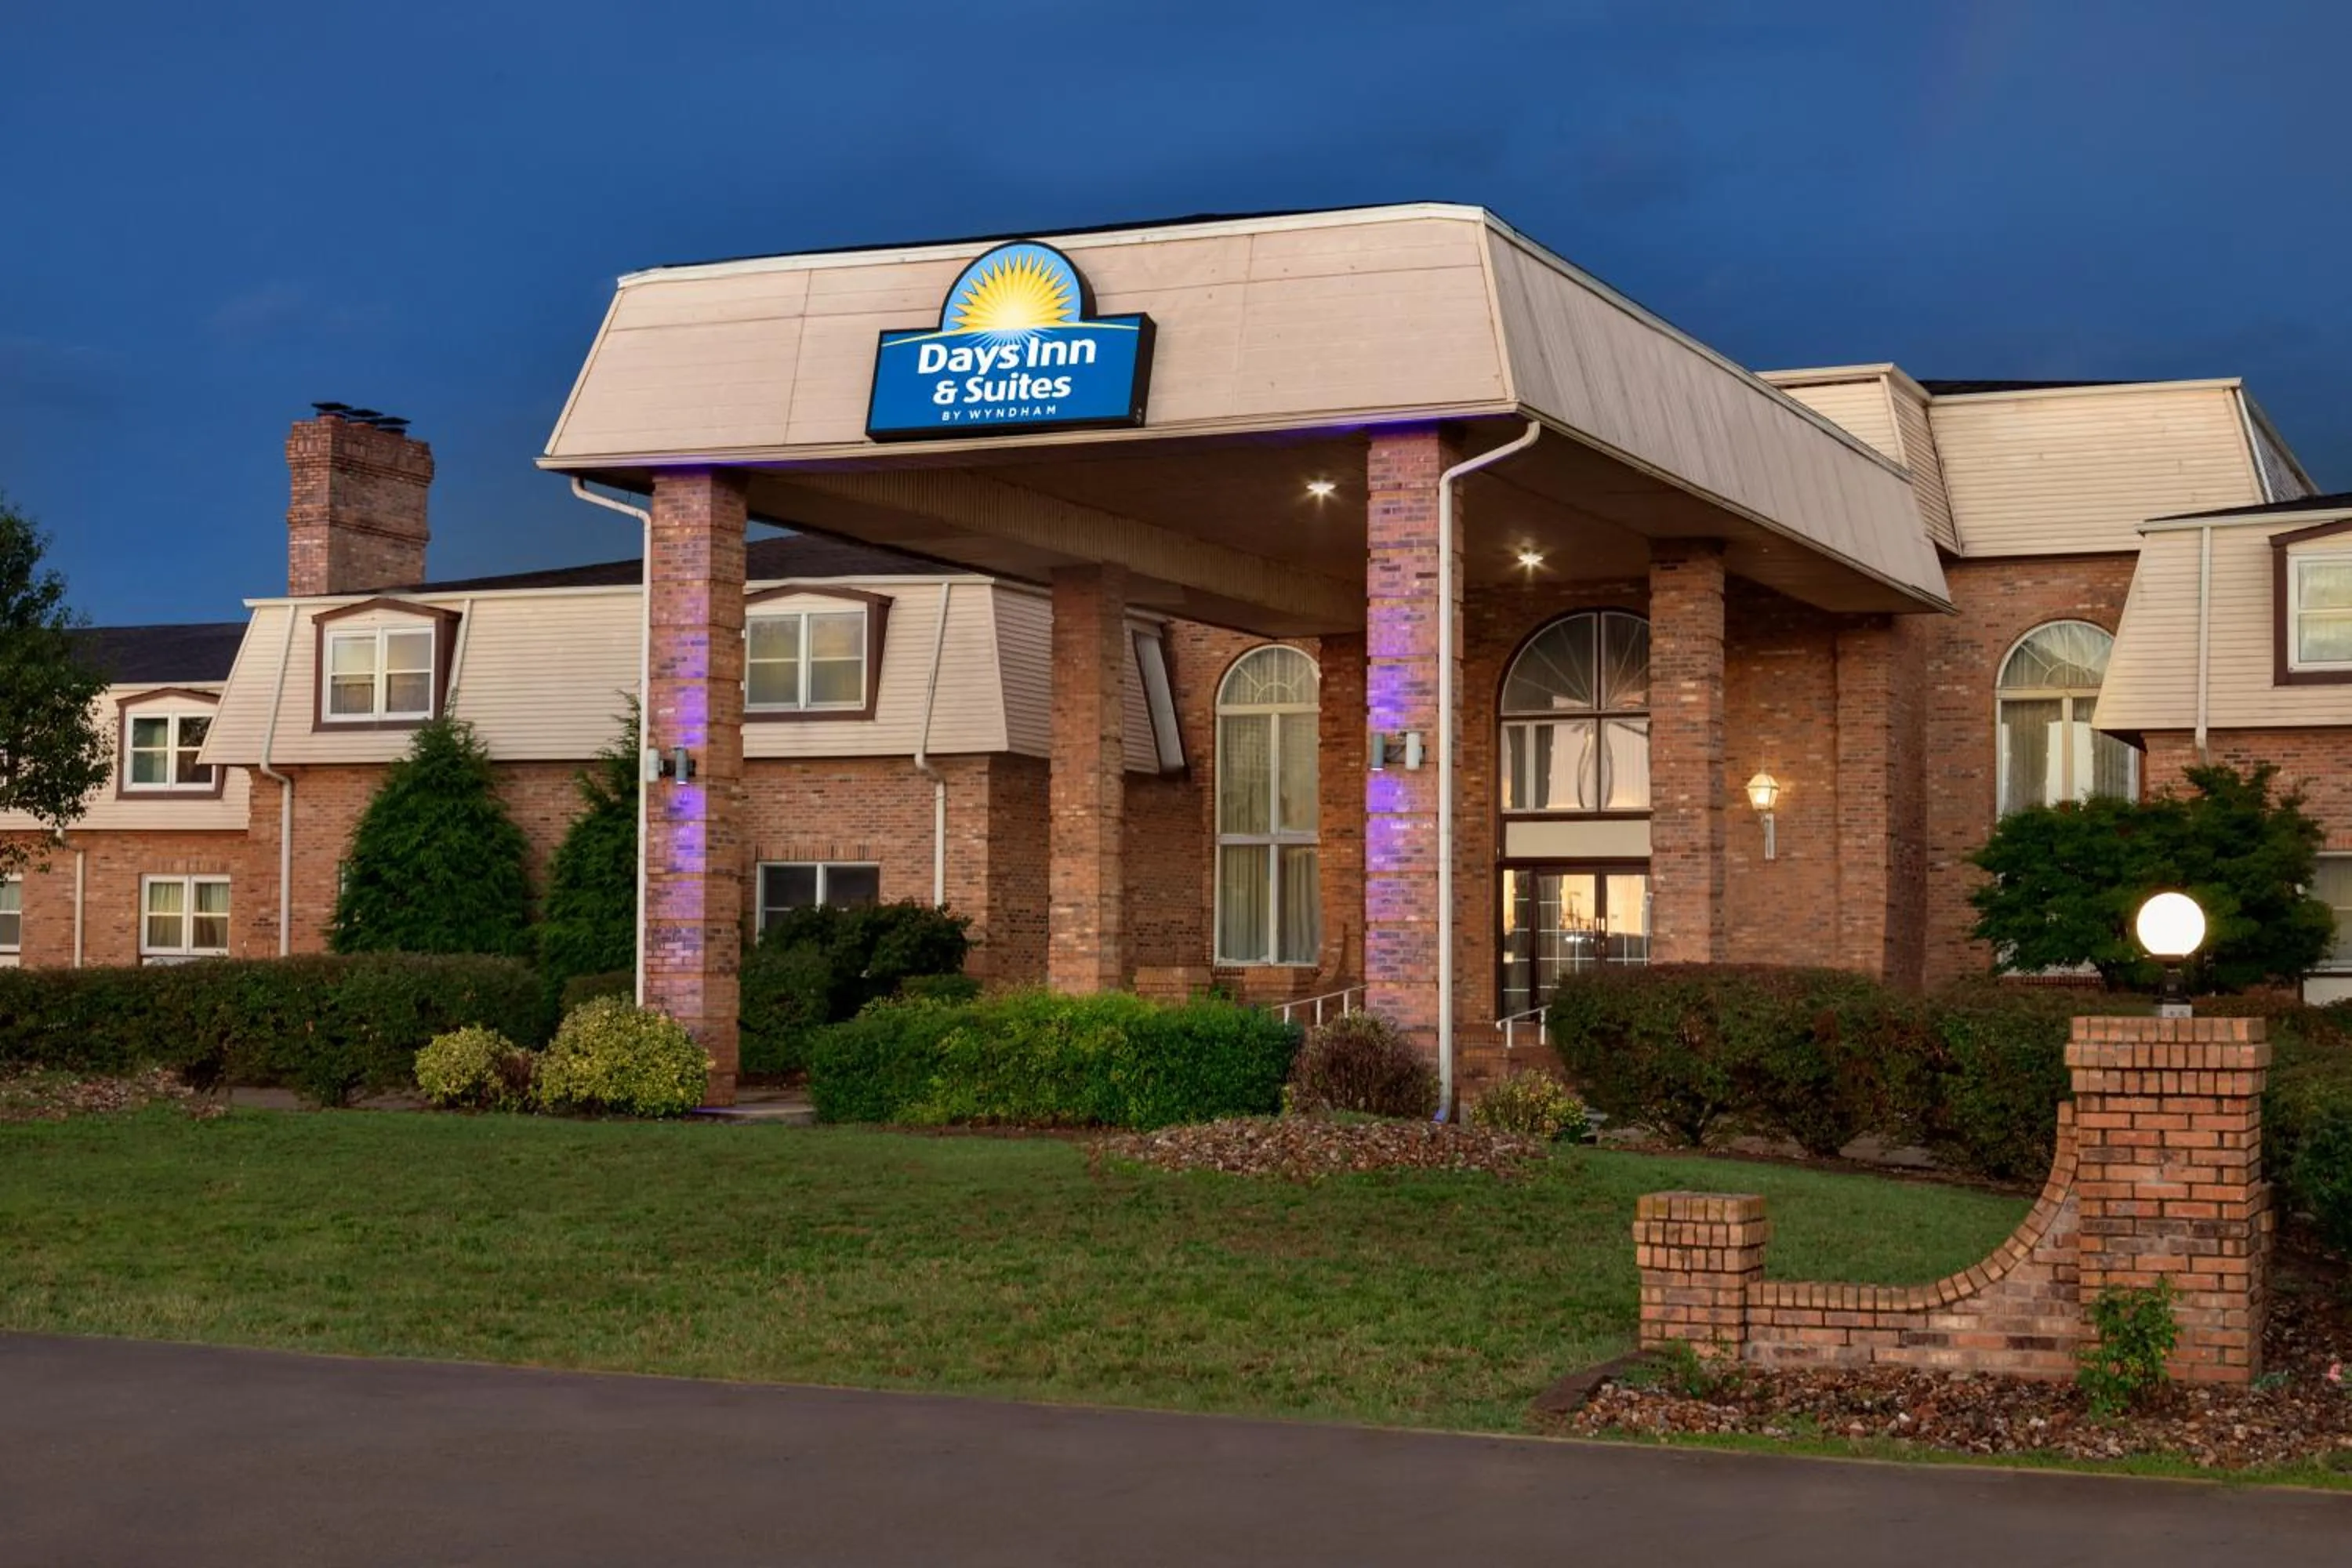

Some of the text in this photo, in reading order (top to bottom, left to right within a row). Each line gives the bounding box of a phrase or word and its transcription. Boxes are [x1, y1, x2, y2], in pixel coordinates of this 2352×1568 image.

[918, 337, 1096, 376] Days Inn
[932, 372, 1072, 405] & Suites
[942, 405, 1057, 421] BY WYNDHAM
